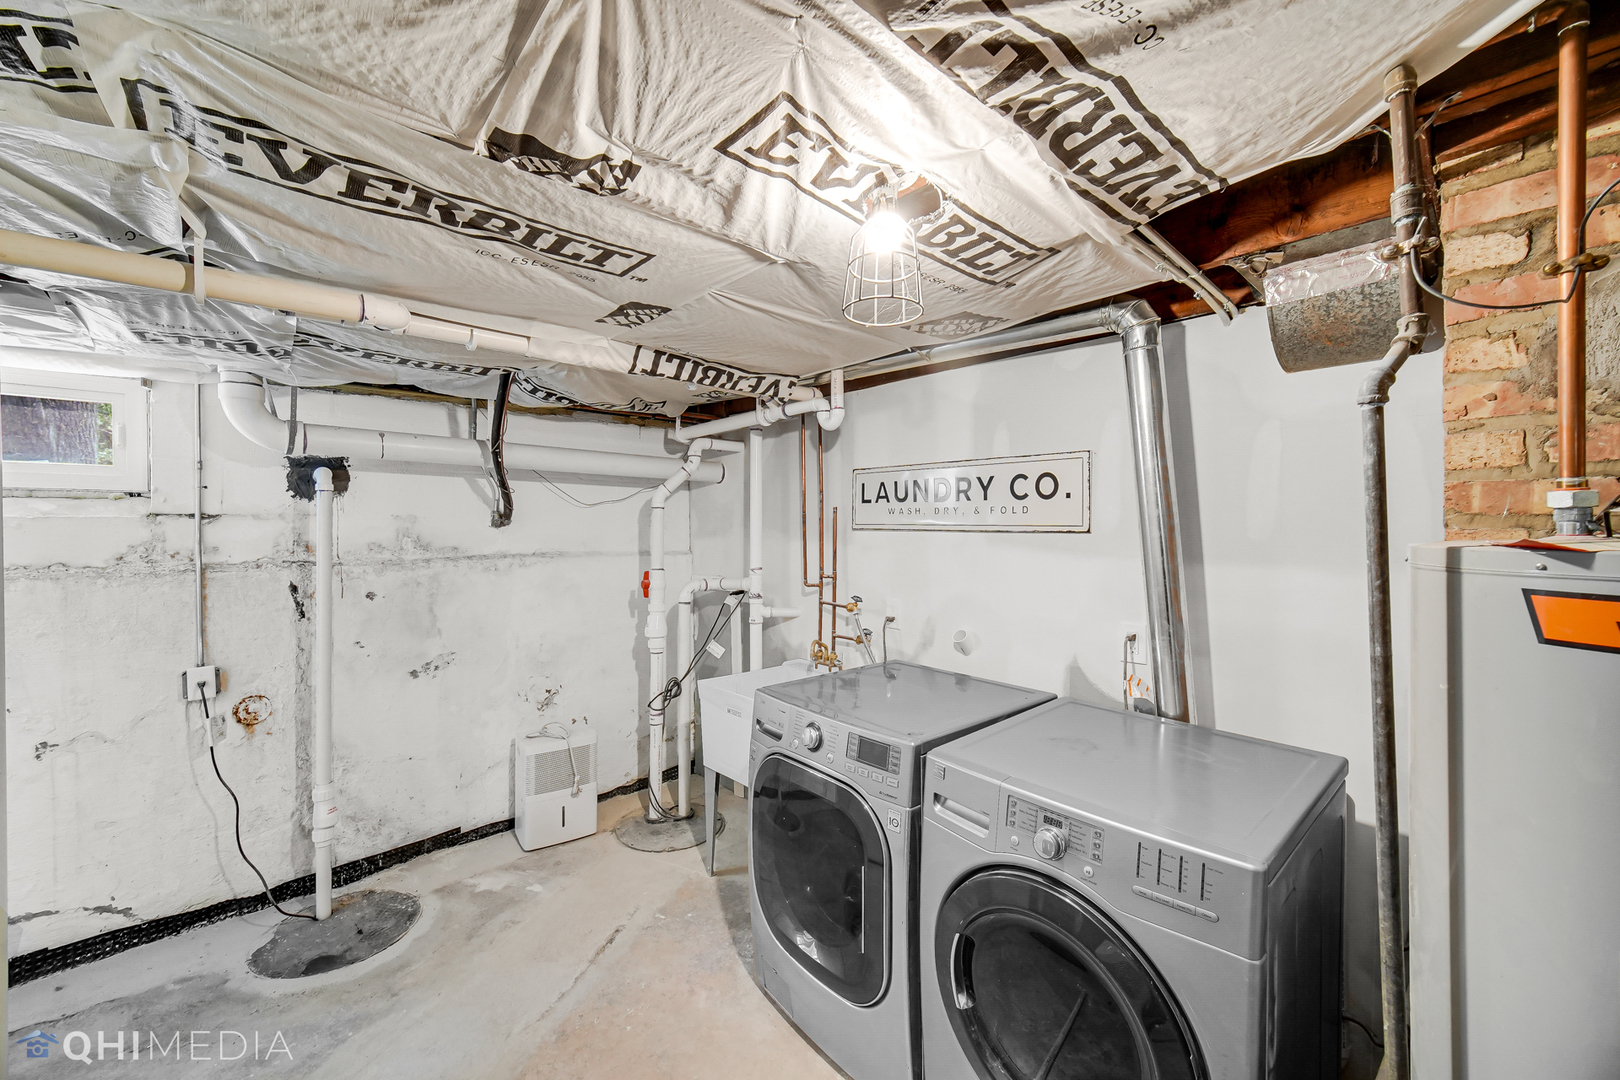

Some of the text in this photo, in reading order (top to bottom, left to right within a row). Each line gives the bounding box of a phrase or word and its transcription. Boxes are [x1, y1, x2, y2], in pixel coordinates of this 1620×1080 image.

[861, 471, 1071, 504] LAUNDRY CO.
[888, 505, 1029, 516] WASH, DRY, & FOLD
